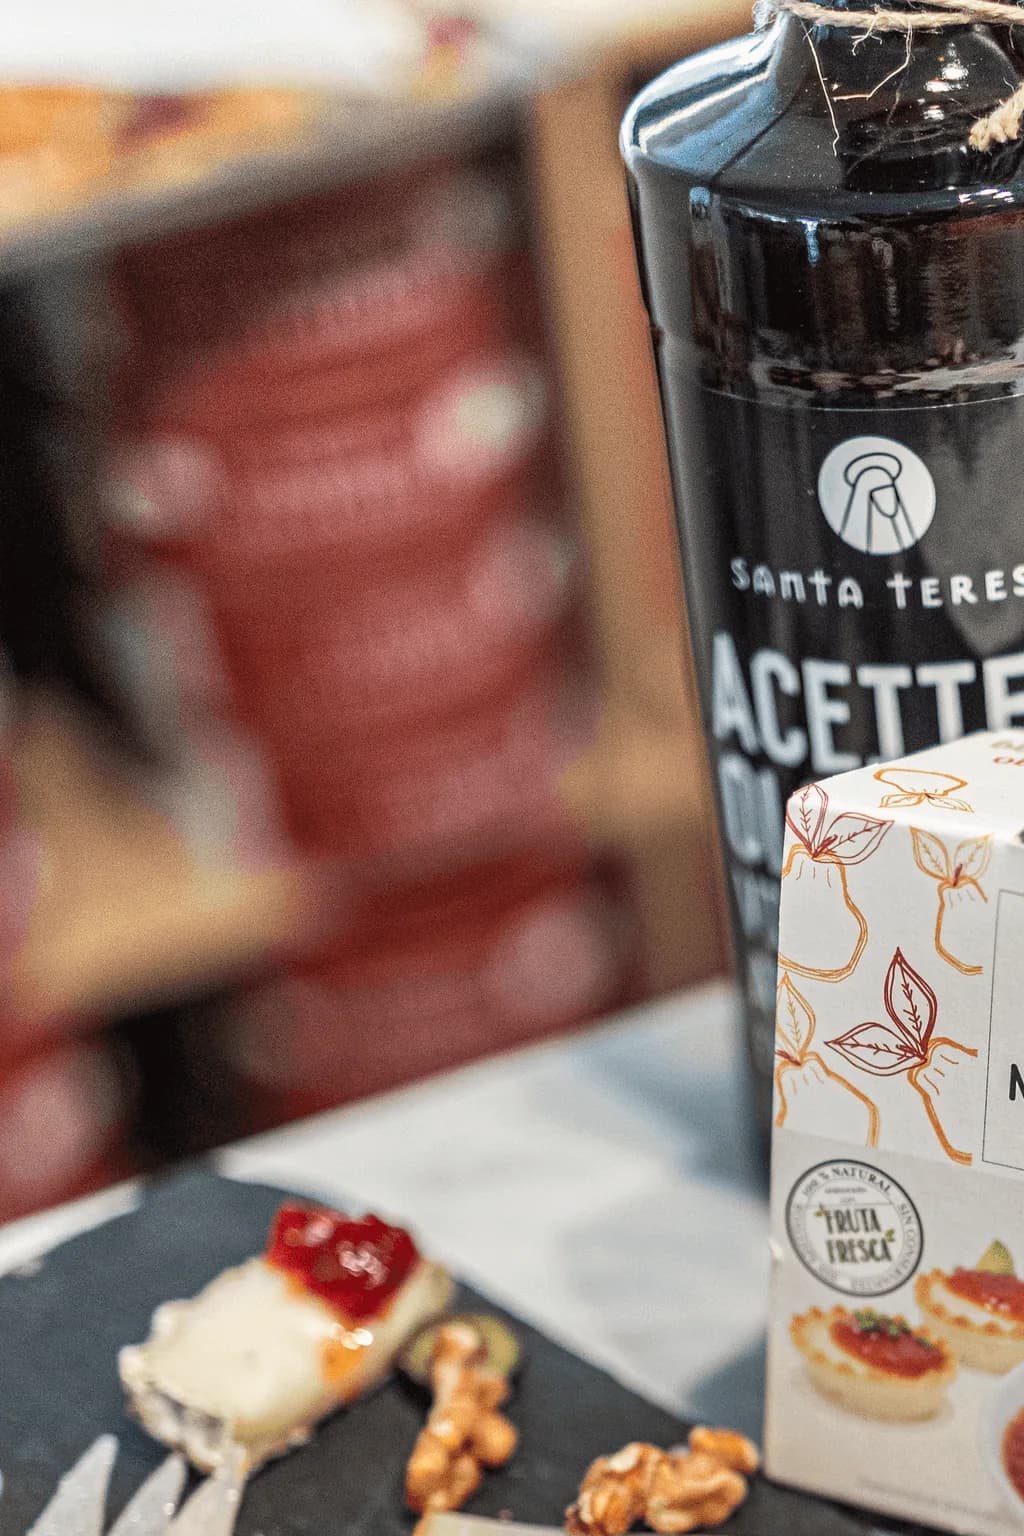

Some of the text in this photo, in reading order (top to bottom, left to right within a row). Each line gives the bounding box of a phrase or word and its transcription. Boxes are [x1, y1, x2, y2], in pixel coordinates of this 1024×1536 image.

[730, 558, 864, 609] SANTA
[832, 1167, 891, 1193] NATURAL
[825, 1208, 881, 1234] FRUTA
[826, 1238, 892, 1263] FRESCA
